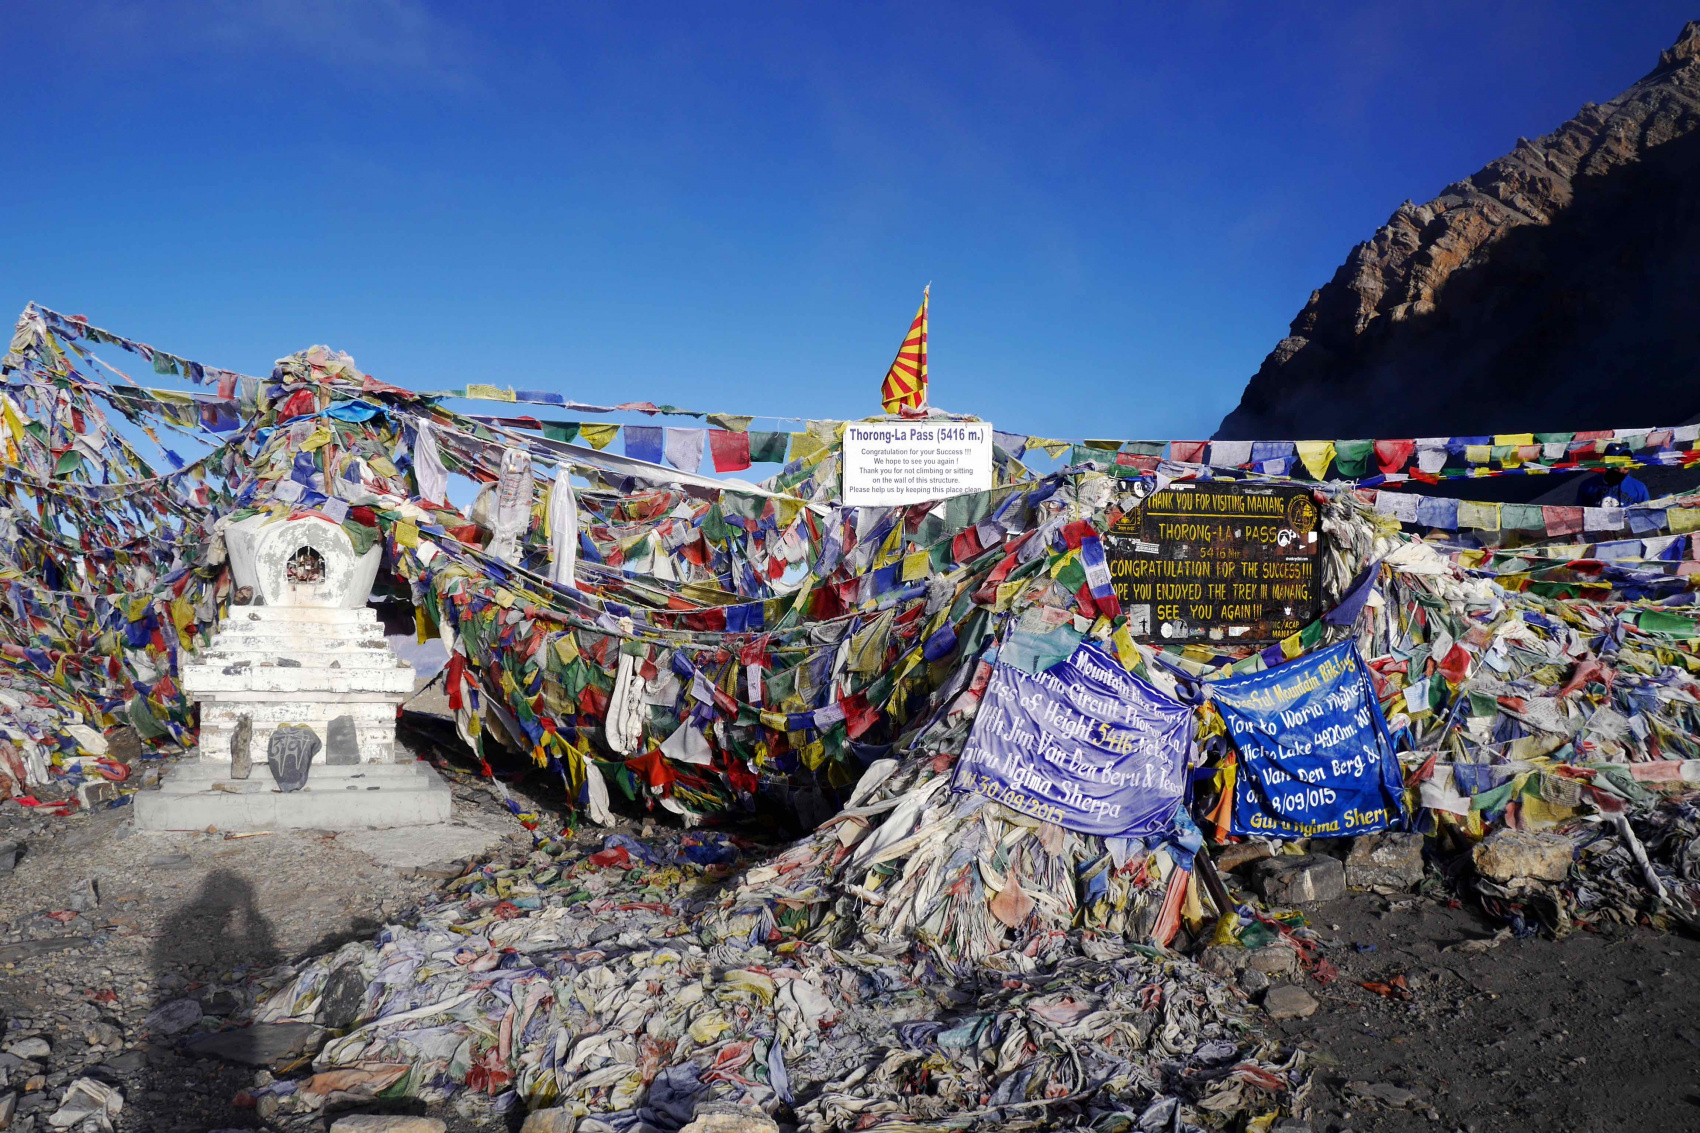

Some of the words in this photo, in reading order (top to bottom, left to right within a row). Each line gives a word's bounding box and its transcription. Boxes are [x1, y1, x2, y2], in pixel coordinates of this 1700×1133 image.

[850, 428, 906, 444] Thorong-La
[910, 428, 934, 441] Pass
[937, 428, 965, 444] (5416
[968, 428, 984, 444] m.)
[861, 448, 908, 457] Congratulation
[920, 449, 935, 457] your
[937, 458, 955, 466] again
[894, 476, 907, 484] wall
[908, 476, 915, 484] of
[916, 467, 944, 476] climbing
[953, 467, 974, 476] sitting
[871, 486, 886, 494] help
[896, 486, 905, 495] by
[905, 486, 931, 495] keeping
[945, 486, 963, 495] place
[1176, 493, 1193, 511] YOU
[1195, 493, 1211, 511] FOR
[1212, 494, 1245, 513] VISITING
[1247, 495, 1284, 514] MANANG
[1159, 523, 1232, 543] THORONG-LA
[1245, 525, 1277, 543] PASS
[1200, 547, 1226, 559] 5416
[1110, 560, 1210, 578] CONGRATULATION
[1216, 561, 1236, 578] FOR
[1241, 562, 1258, 579] THE
[1112, 583, 1129, 601] OPE
[1133, 583, 1152, 601] YOU
[1156, 583, 1202, 601] ENJOYED
[1208, 583, 1226, 601] THE
[1233, 583, 1257, 601] TREK
[1260, 584, 1268, 600] IN
[1157, 604, 1180, 621] SEE
[1190, 604, 1213, 620] YOU
[1076, 650, 1131, 698] Mountain
[1272, 670, 1321, 703] Mountain
[1068, 683, 1121, 719] Circuit
[1020, 693, 1043, 711] of
[1043, 700, 1096, 741] Height
[1092, 722, 1136, 755] 5416
[1259, 718, 1278, 736] to
[1278, 740, 1313, 760] Lake
[1314, 723, 1358, 749] 4920m.
[1003, 715, 1036, 751] Jim
[1037, 730, 1067, 768] Van
[1068, 747, 1099, 780] Den
[1142, 763, 1156, 788] &
[1262, 766, 1292, 785] Van
[1297, 766, 1327, 783] Den
[1331, 754, 1367, 777] Berg
[1362, 744, 1381, 764] &
[1001, 752, 1054, 796] Ngima
[1057, 780, 1122, 822] Sherpa
[975, 775, 1067, 823] 30/09/2015
